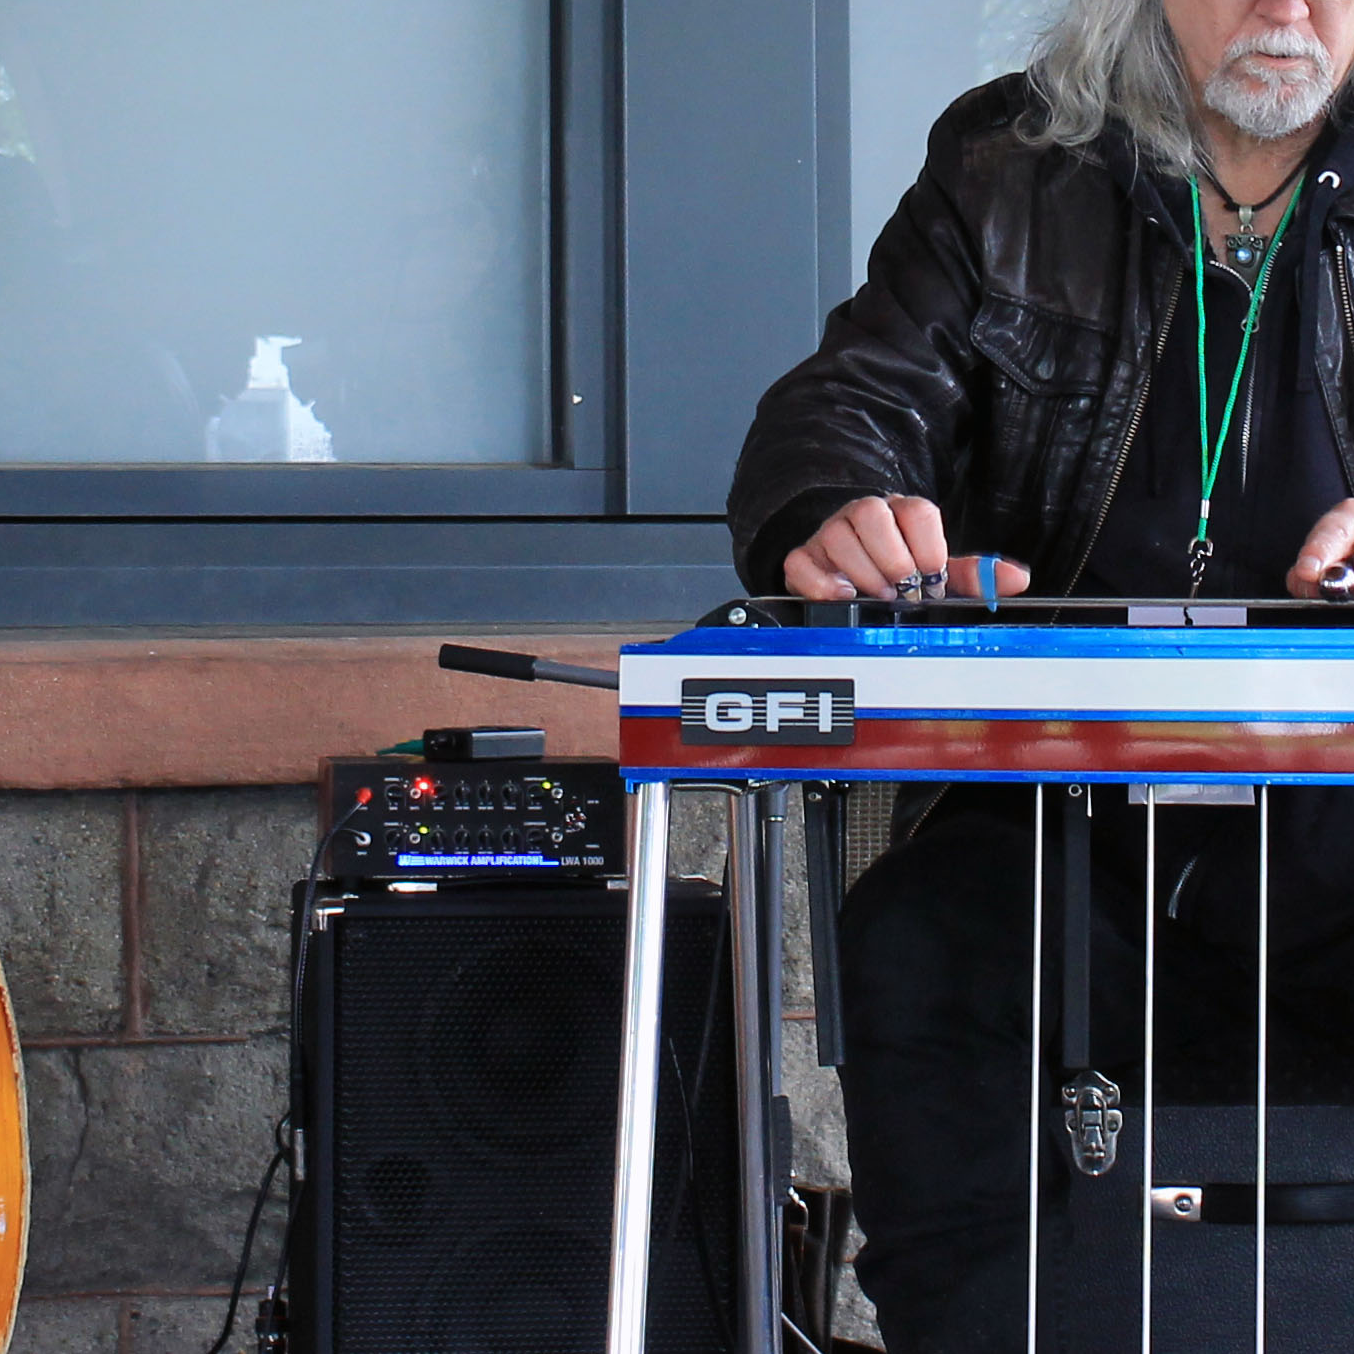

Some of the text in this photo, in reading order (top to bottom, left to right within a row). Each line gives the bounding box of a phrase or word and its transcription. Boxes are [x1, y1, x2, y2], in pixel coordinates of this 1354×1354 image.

[705, 691, 833, 734] GFI
[425, 855, 469, 866] WARWICK
[470, 855, 541, 866] AMPLIFICATION
[560, 856, 581, 866] LWA
[583, 856, 604, 866] 1000
